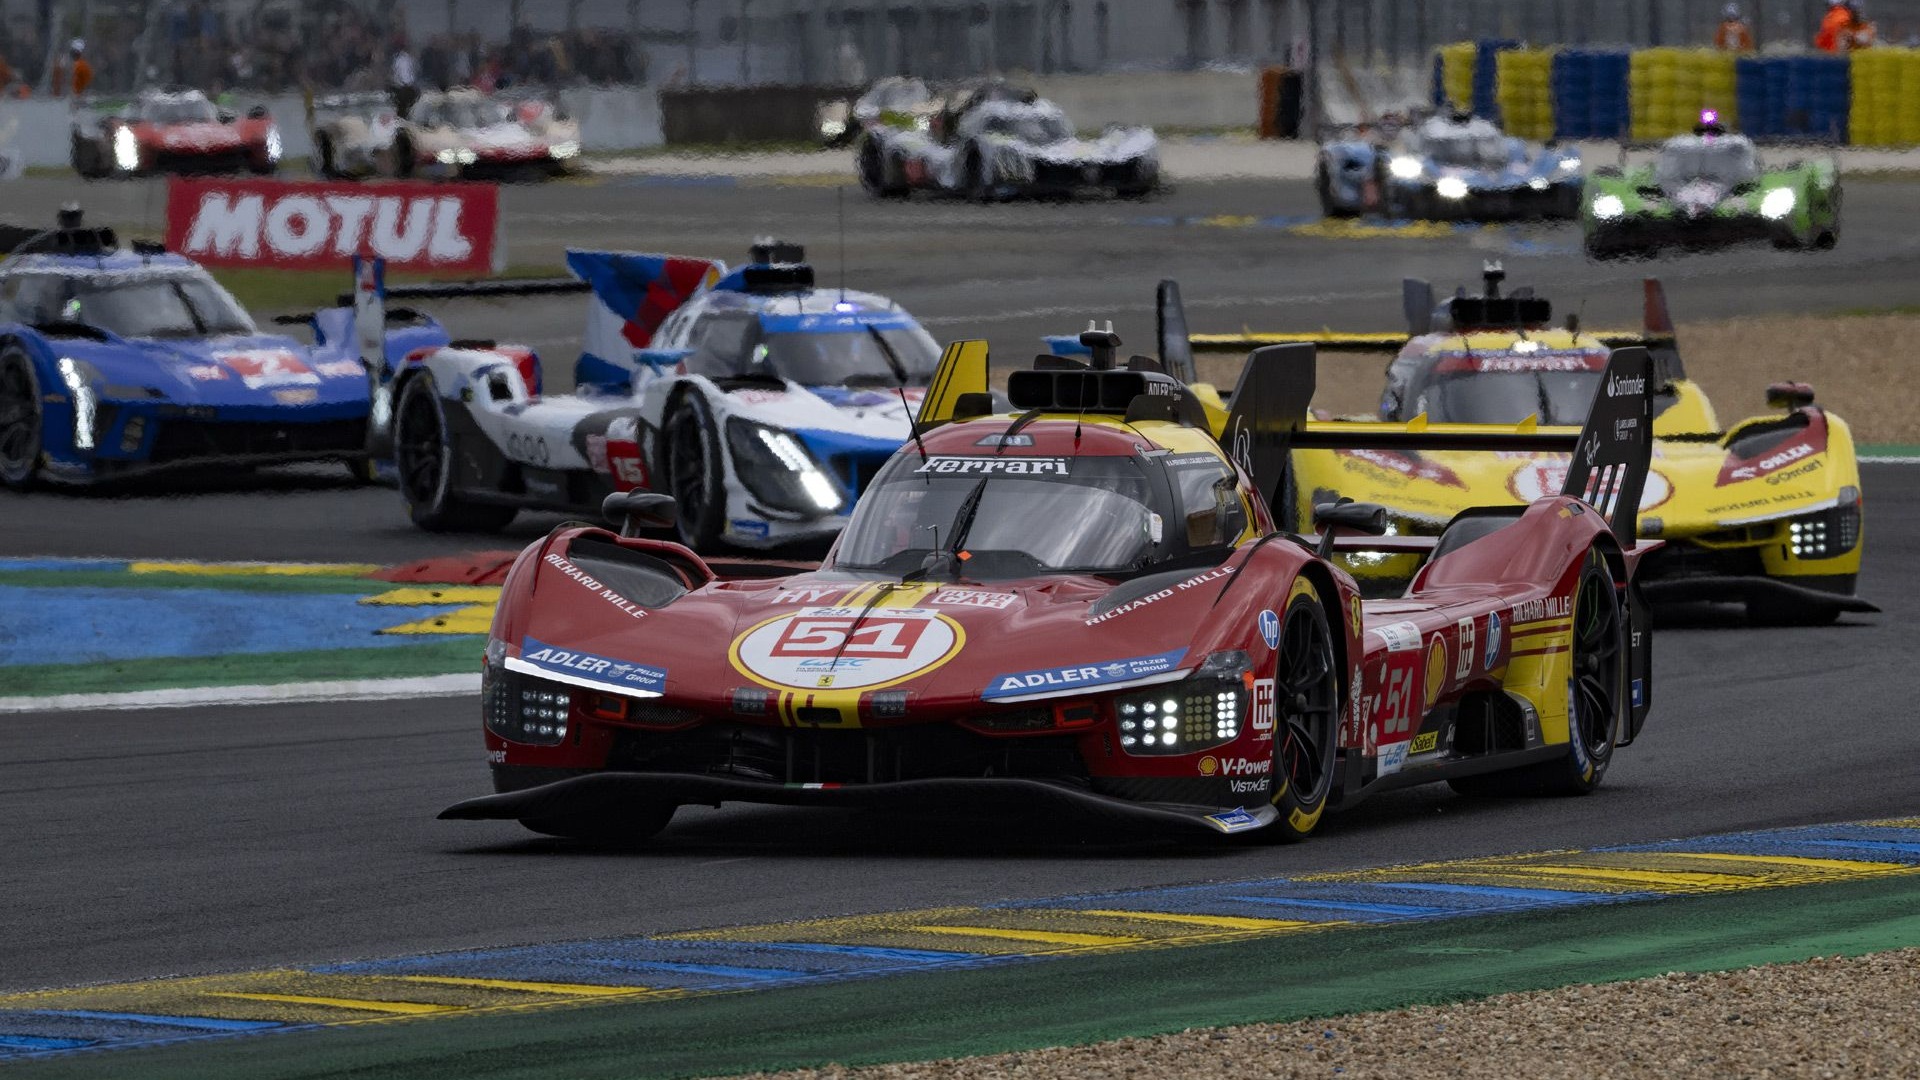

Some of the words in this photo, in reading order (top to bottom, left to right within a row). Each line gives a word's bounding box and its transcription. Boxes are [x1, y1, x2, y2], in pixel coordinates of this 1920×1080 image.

[186, 189, 473, 263] MOTUL
[1615, 373, 1645, 396] Santander
[611, 457, 644, 483] 15
[913, 456, 1069, 475] Ferrari
[544, 553, 603, 591] RICHARD
[600, 587, 648, 619] MILLE
[1085, 589, 1174, 626] RICHARD
[1177, 565, 1237, 591] MILLE
[937, 595, 1007, 608] CAR
[1511, 598, 1544, 623] RICHARD
[1544, 595, 1570, 617] MILLE
[782, 621, 908, 653] 51
[1263, 611, 1278, 649] hp
[525, 648, 612, 673] ADLER
[633, 667, 664, 678] PELZER
[1129, 657, 1168, 667] PELZER
[1132, 663, 1170, 673] GROUP
[626, 674, 657, 684] GROUP
[1000, 666, 1101, 691] ADLER
[1384, 666, 1413, 734] 51
[1221, 758, 1271, 775] V-Power
